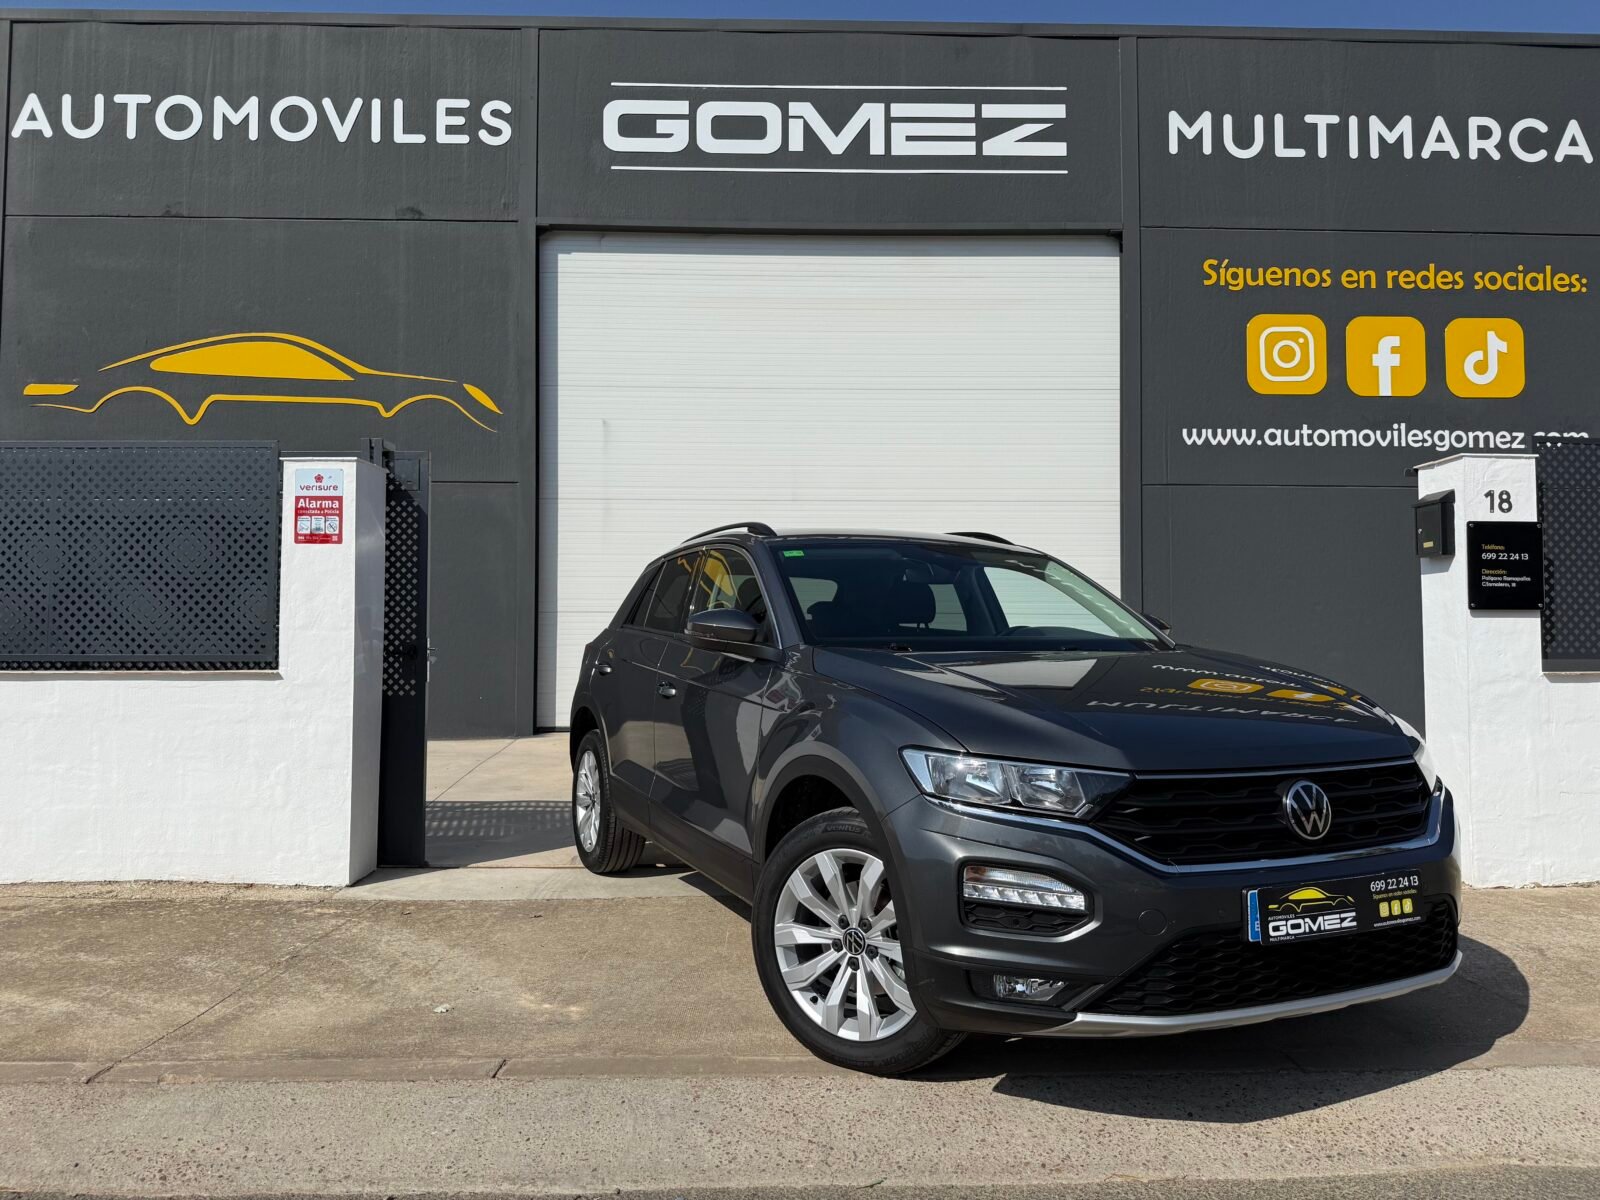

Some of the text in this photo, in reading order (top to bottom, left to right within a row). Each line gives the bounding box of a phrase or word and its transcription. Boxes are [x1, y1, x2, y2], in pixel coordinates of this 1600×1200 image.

[10, 92, 512, 146] AUTOMOVILES
[602, 99, 1068, 157] GOMEZ
[1168, 110, 1594, 164] MULTIMARCA
[1202, 258, 1588, 293] Síguenos en redes sociales:
[297, 498, 339, 508] Alarma
[1484, 489, 1513, 514] 18
[1481, 552, 1496, 560] 699
[1498, 552, 1508, 560] 22
[1370, 875, 1419, 892] 699 22 24 13
[1268, 911, 1357, 937] GOMEZ
